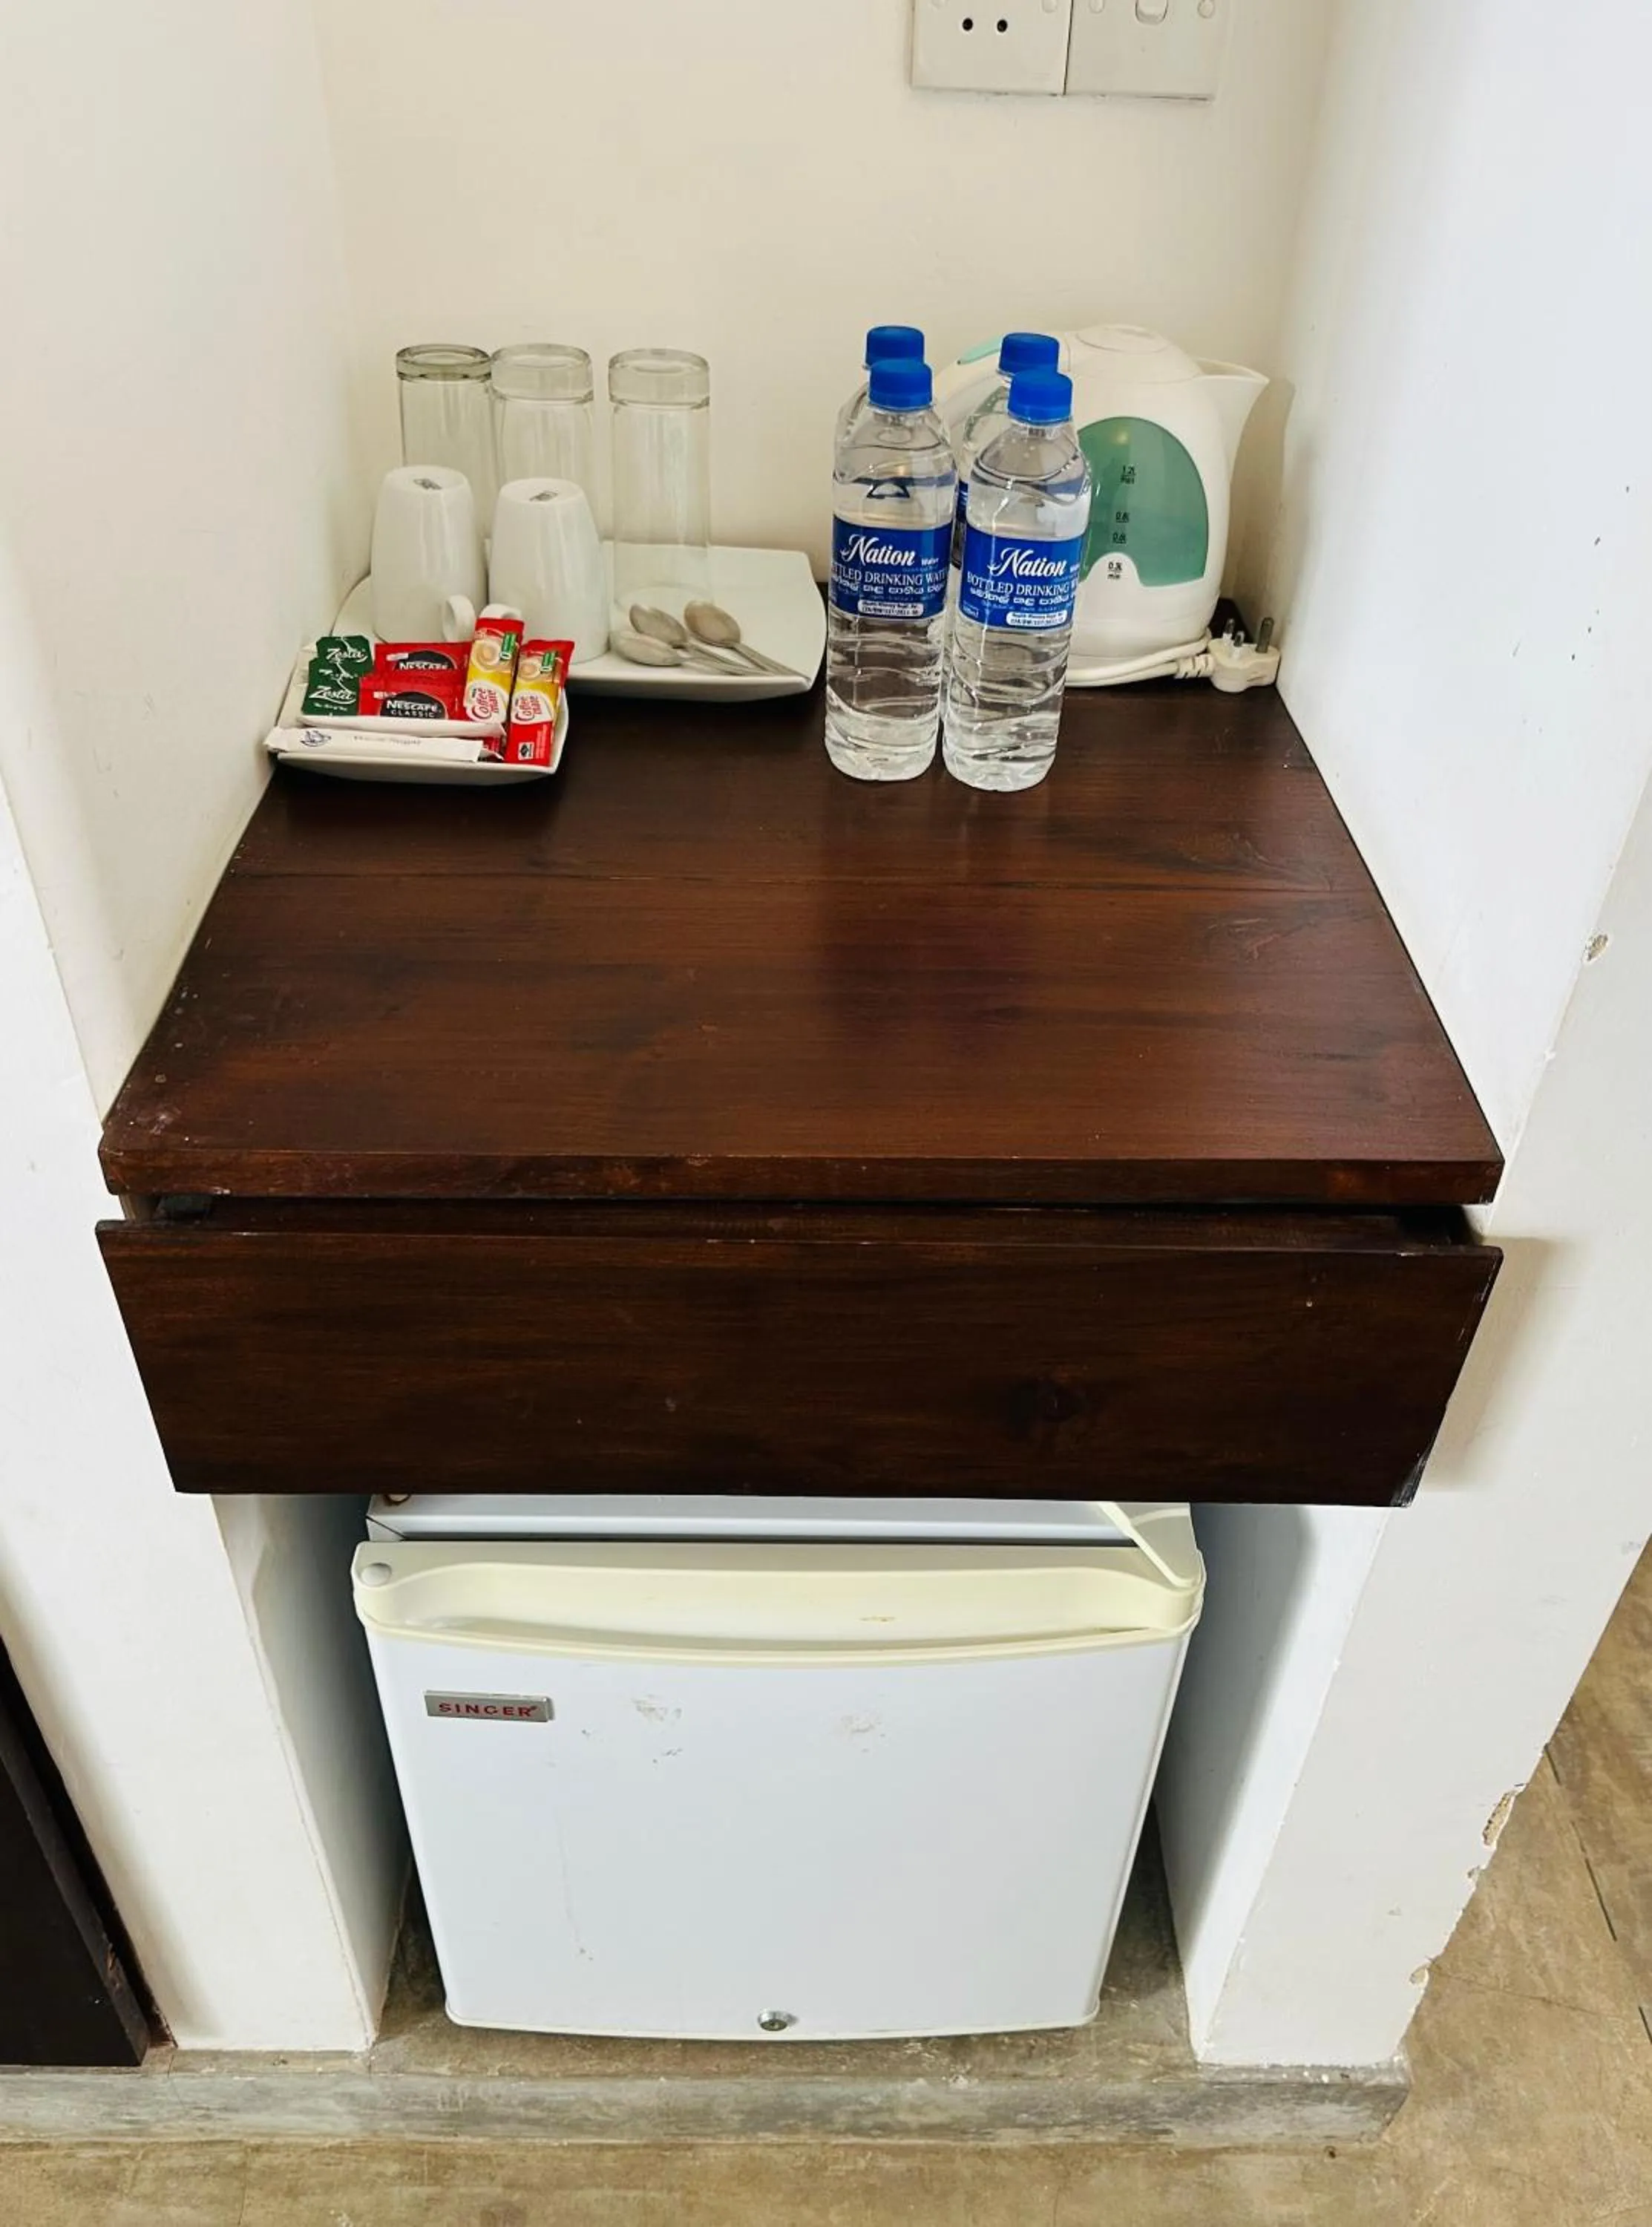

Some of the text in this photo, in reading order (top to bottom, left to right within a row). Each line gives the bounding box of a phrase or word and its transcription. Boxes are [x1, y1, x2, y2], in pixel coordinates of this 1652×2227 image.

[840, 534, 917, 566] Nation
[987, 547, 1067, 578] Nation
[865, 571, 923, 586] DRINKING
[967, 571, 1014, 595] BOTTLED
[1017, 581, 1069, 597] DRINKING
[309, 685, 357, 704] Zesta
[390, 710, 435, 719] CLASSIC
[439, 1702, 532, 1718] SINGER
